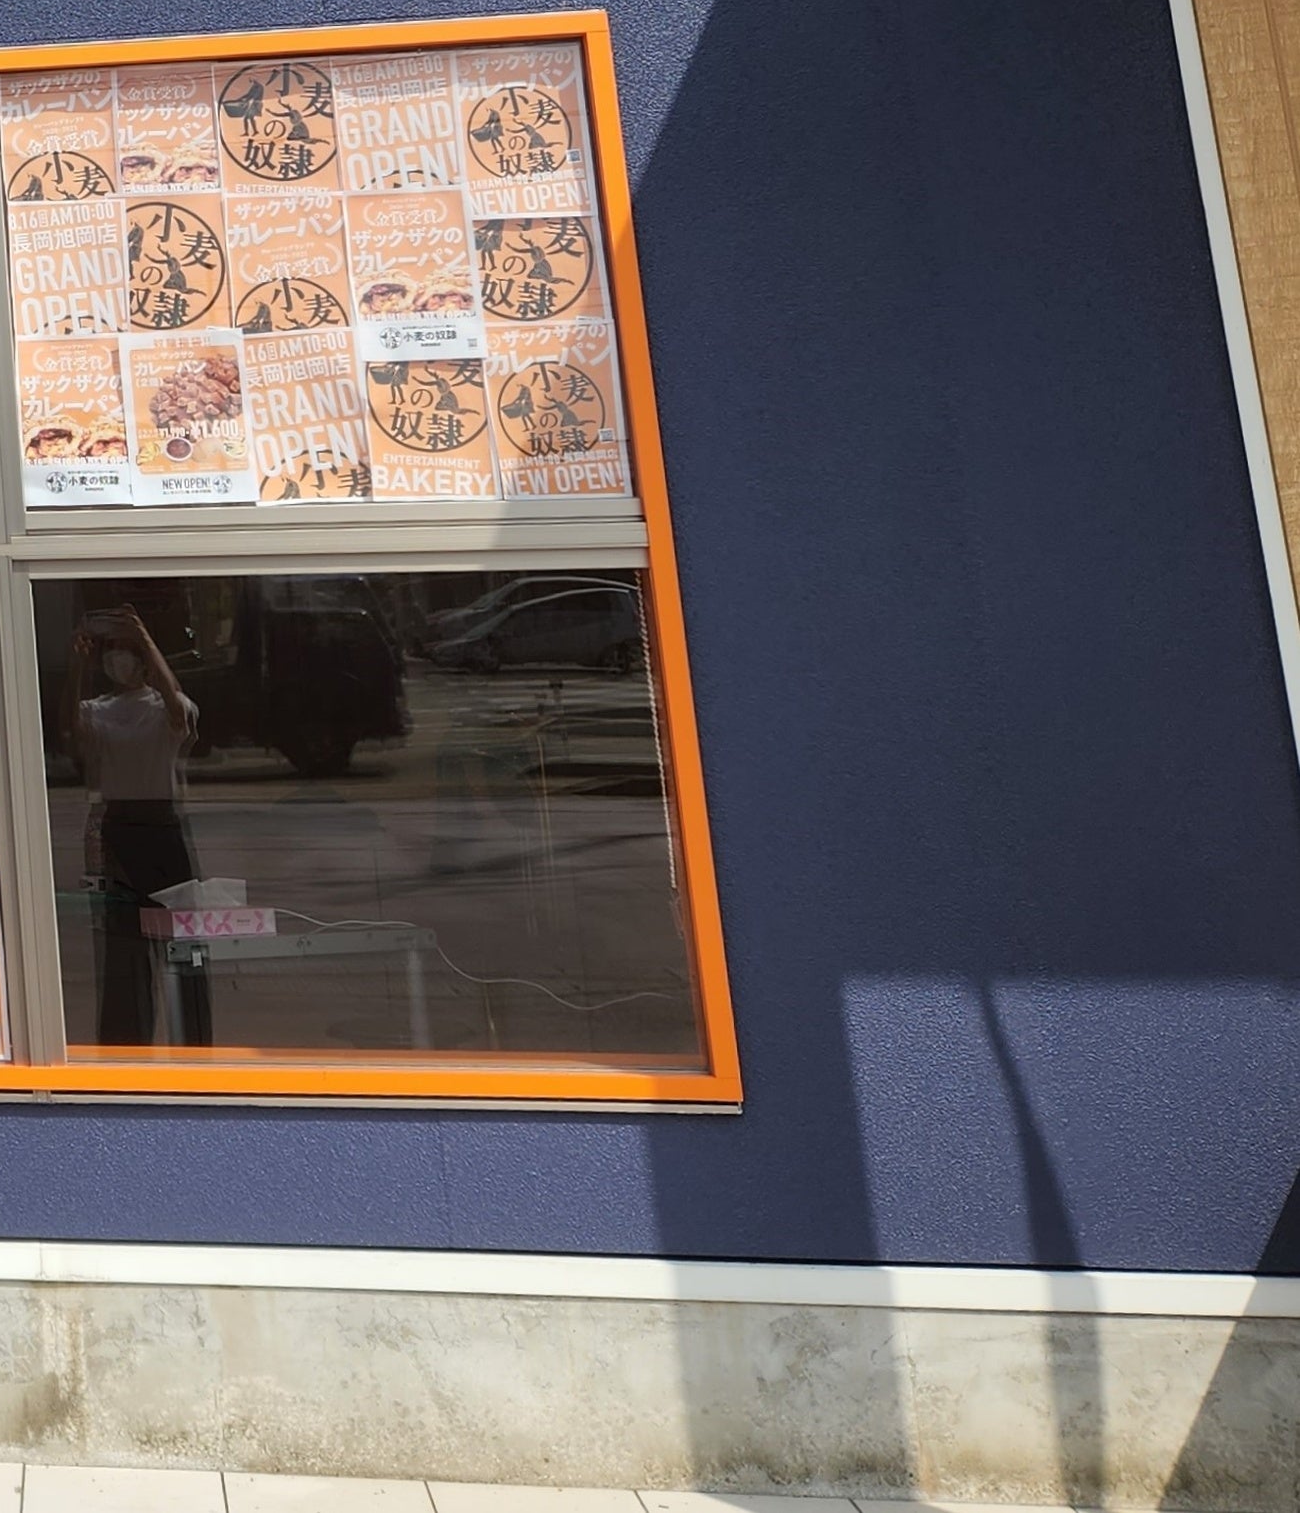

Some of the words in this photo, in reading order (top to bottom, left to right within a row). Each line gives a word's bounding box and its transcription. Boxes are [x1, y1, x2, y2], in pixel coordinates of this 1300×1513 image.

[455, 69, 577, 102] カレーパン
[1, 89, 113, 125] カレーパン
[264, 120, 286, 137] の
[340, 100, 454, 150] GRAND
[347, 141, 461, 192] OPEN!
[234, 195, 332, 221] ザックザクの
[470, 189, 517, 215] NEW
[522, 181, 591, 212] OPEN!
[12, 223, 118, 254] 長岡旭岡店
[227, 212, 344, 249] カレーパン
[352, 227, 462, 249] ザックザクの
[15, 247, 122, 294] GRAND
[141, 266, 163, 285] の
[353, 248, 466, 274] カレーパン
[503, 256, 526, 275] の
[21, 288, 129, 335] OPEN!
[480, 273, 557, 317] 奴隷
[134, 361, 206, 376] カレーパン
[486, 343, 611, 377] カレーパン
[23, 396, 123, 419] カレーパン
[250, 379, 361, 431] GRAND
[410, 388, 433, 407] の
[389, 407, 464, 448] 奴隷
[255, 418, 368, 477] OPEN!
[383, 453, 480, 469] ENTERTAINMENT
[162, 478, 182, 489] NEW
[184, 477, 211, 489] OPEN!
[372, 464, 492, 496] BAKERY
[501, 467, 548, 495] NEW
[554, 460, 625, 493] OPEN!
